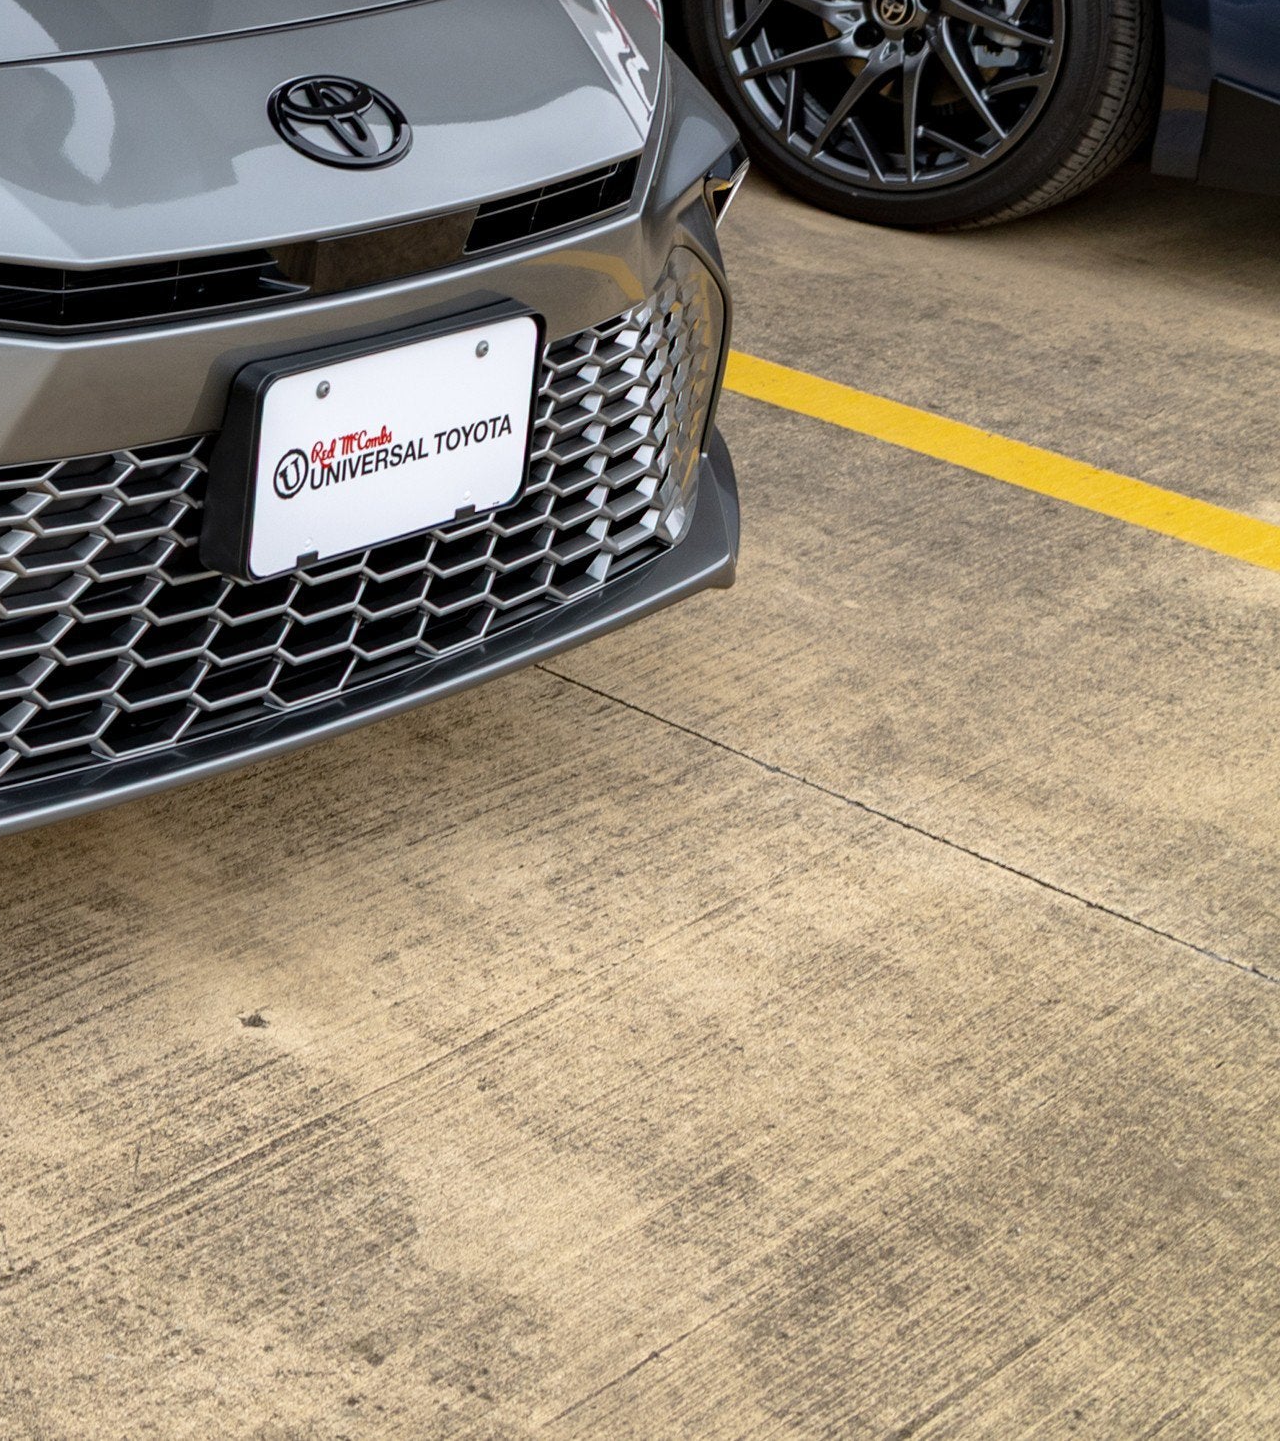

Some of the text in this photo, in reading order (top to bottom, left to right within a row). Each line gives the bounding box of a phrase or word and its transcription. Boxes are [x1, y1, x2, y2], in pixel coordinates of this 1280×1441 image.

[310, 414, 512, 490] UNIVERSAL TOYOTA
[311, 439, 336, 469] Red
